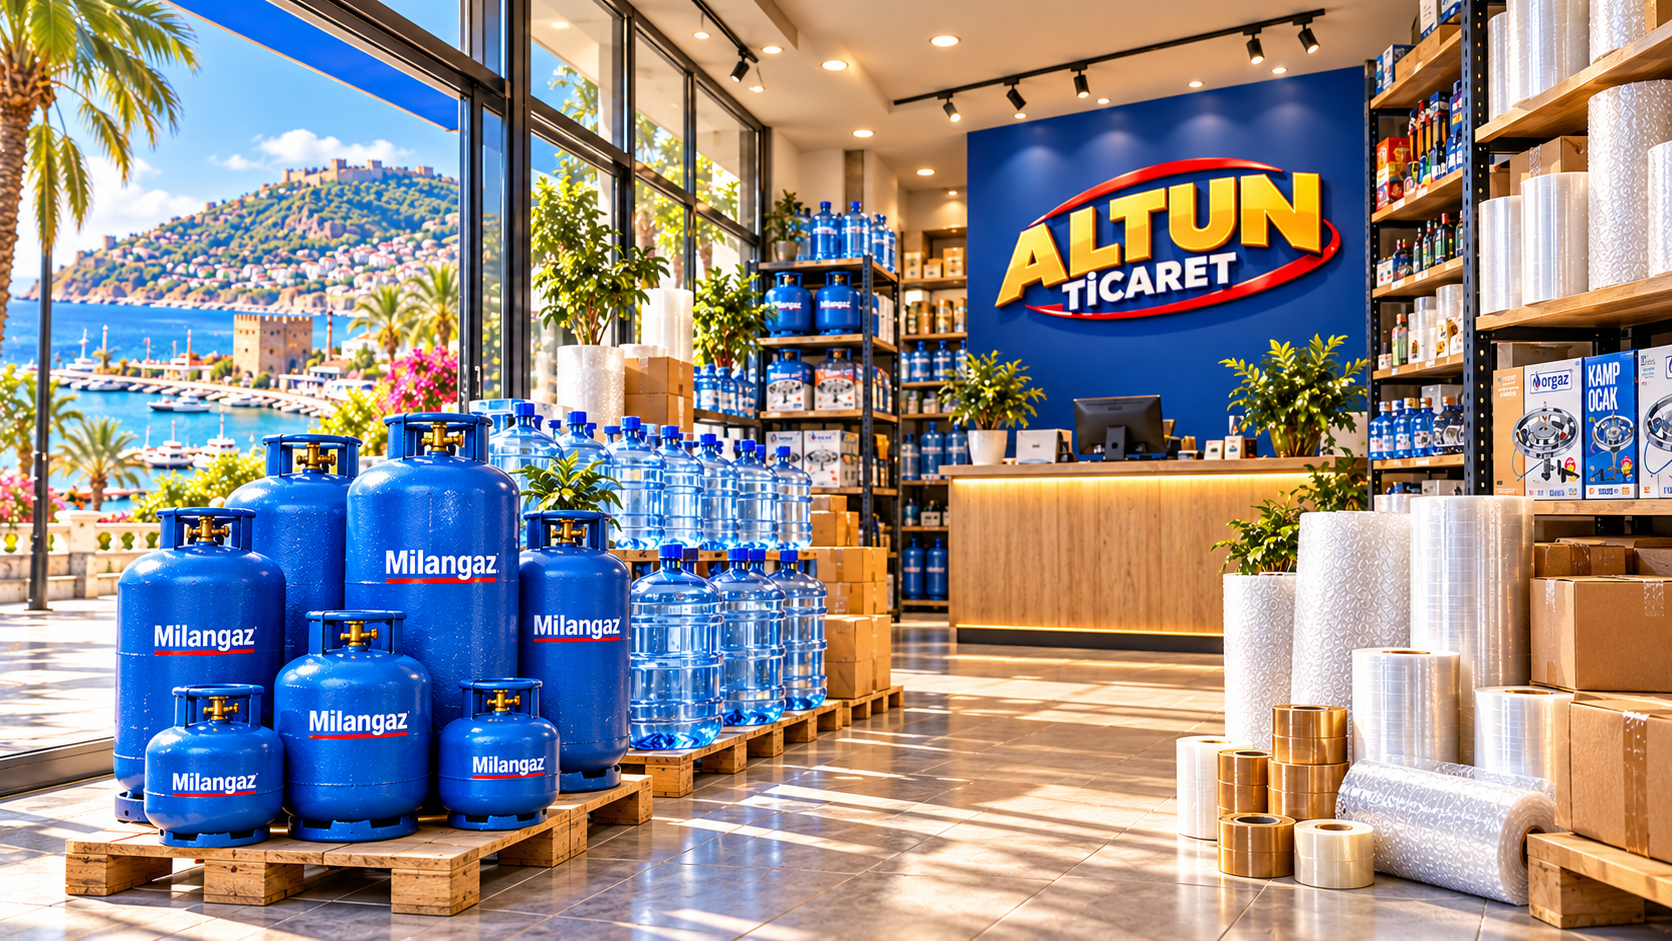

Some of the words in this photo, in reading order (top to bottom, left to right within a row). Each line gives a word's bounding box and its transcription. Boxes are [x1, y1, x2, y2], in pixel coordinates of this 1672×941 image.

[995, 172, 1323, 308] ALTUN
[1588, 361, 1621, 388] KAMP
[1588, 387, 1619, 412] OCAK
[386, 549, 497, 580] Milangaz
[155, 625, 256, 652] Milangaz
[534, 614, 621, 640] Milangaz
[310, 710, 408, 736] Milangaz
[472, 755, 547, 777] Milangaz
[172, 773, 258, 795] Milangaz
